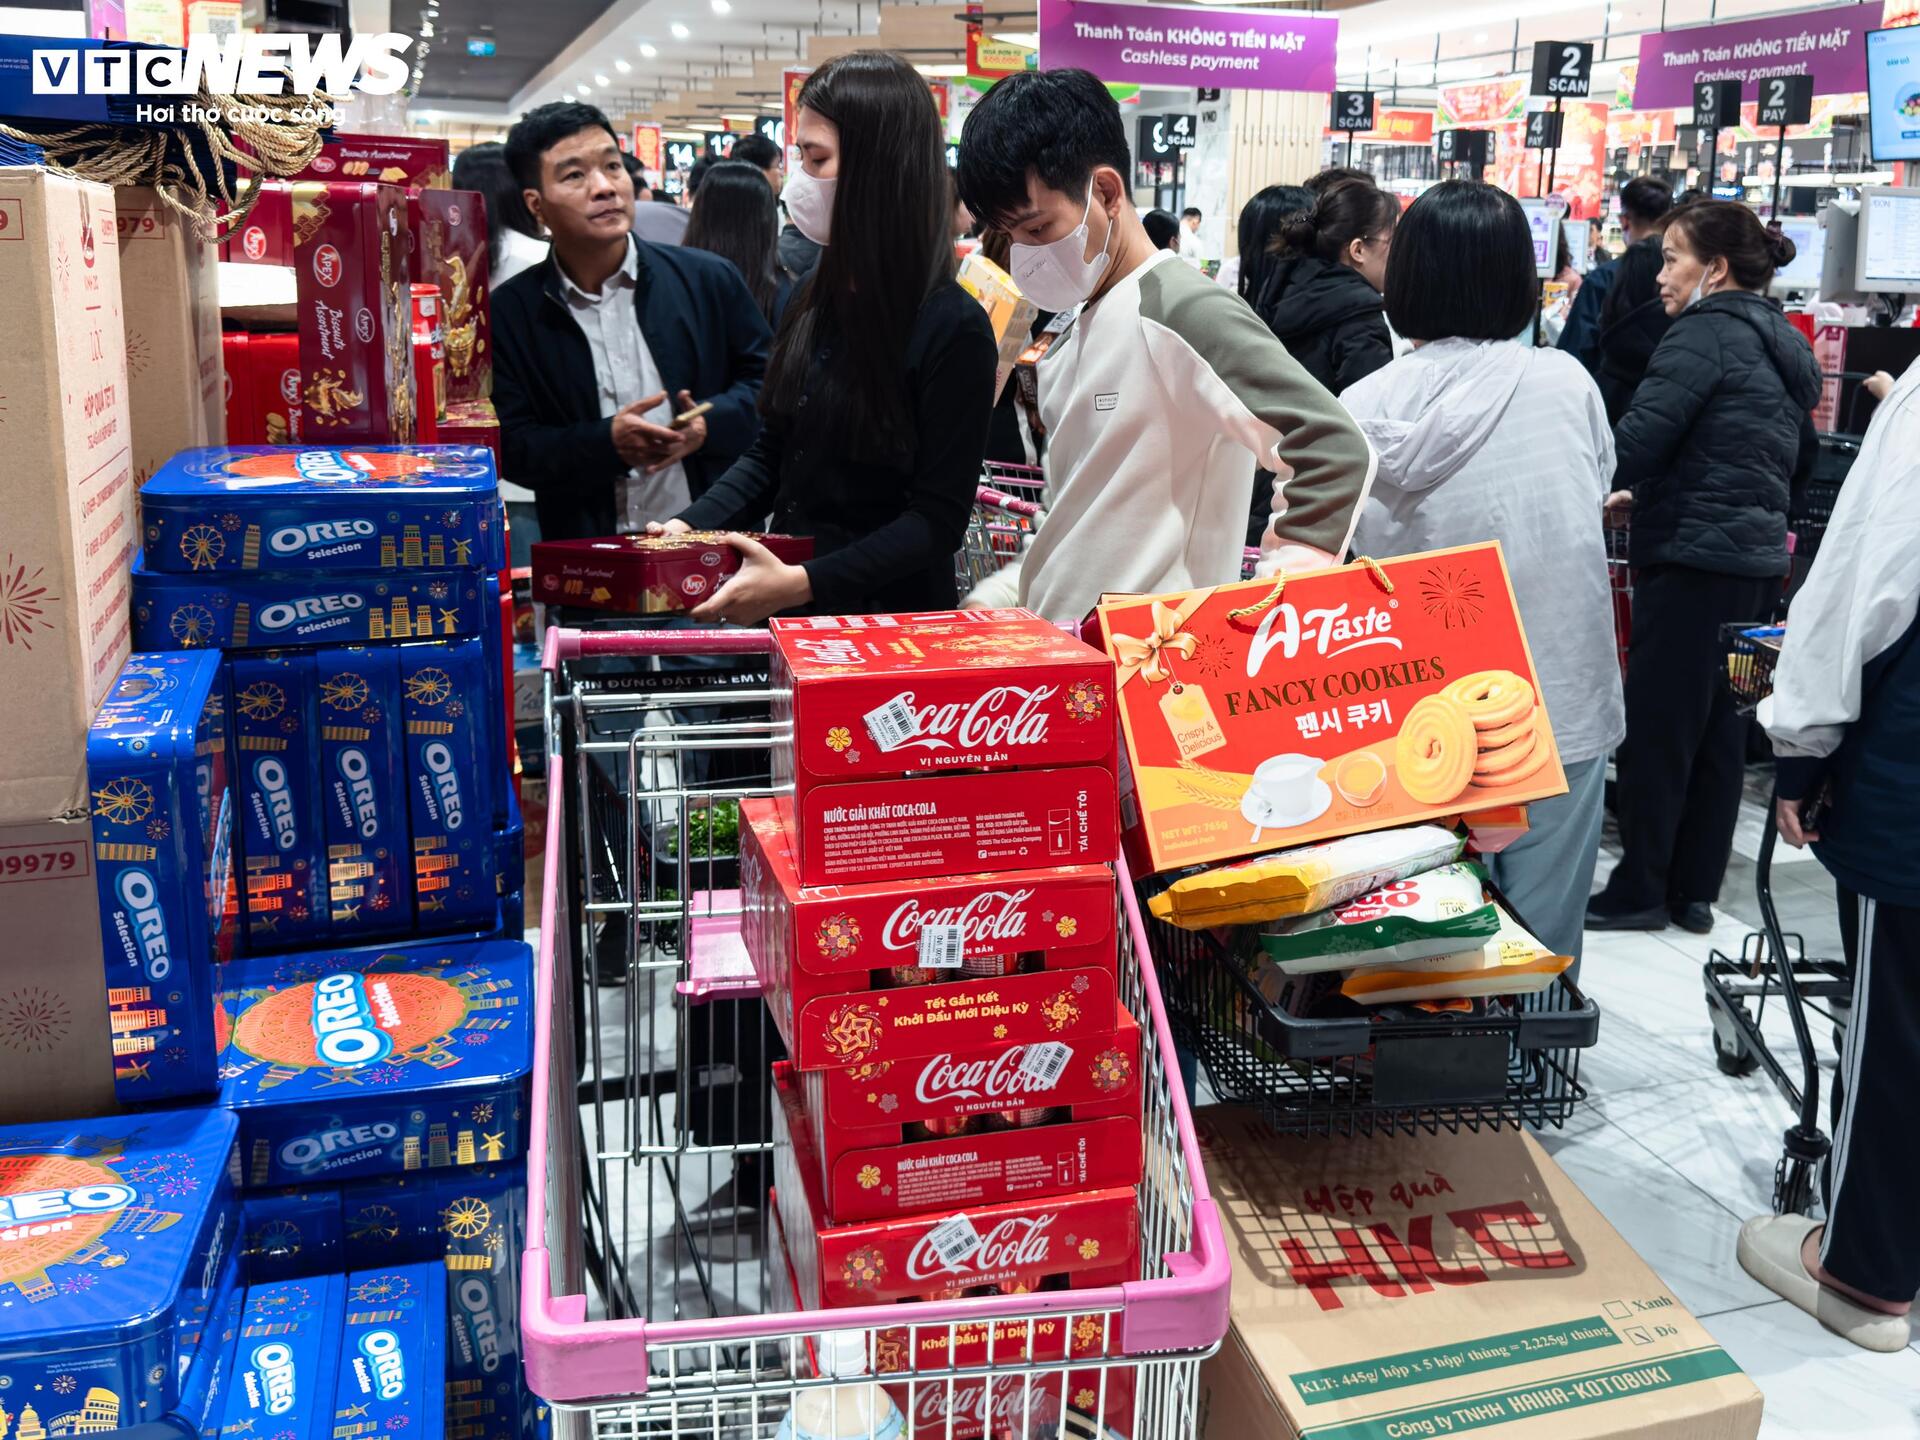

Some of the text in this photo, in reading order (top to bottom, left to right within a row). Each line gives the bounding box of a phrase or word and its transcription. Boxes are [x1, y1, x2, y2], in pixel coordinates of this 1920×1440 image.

[1074, 22, 1124, 40] Thanh
[1127, 26, 1163, 43] Toán
[1167, 27, 1227, 48] KHÔNG
[1270, 31, 1306, 55] MẶT
[1663, 51, 1701, 68] Thanh
[1702, 46, 1731, 65] Toán
[1733, 38, 1783, 60] KHÔNG
[1819, 30, 1851, 56] MẶT
[1120, 49, 1260, 72] Cashless payment
[1560, 46, 1582, 77] 2
[1548, 77, 1588, 94] SCAN
[1701, 86, 1714, 110] 3
[1768, 80, 1786, 107] 2
[1348, 93, 1365, 116] 3
[1763, 108, 1787, 122] PAY
[1174, 116, 1190, 136] 4
[1338, 117, 1372, 129] SCAN
[1530, 114, 1544, 134] 4
[1697, 113, 1716, 126] PAY
[1167, 135, 1195, 146] SCAN
[1527, 136, 1543, 147] PAY
[669, 143, 696, 168] 14
[320, 252, 335, 287] APEX
[314, 299, 335, 361] Assortment
[329, 308, 347, 351] Biscuits
[270, 519, 376, 552] OREO
[307, 541, 362, 560] Selection
[686, 578, 706, 594] APEX
[258, 593, 364, 629] OREO
[297, 616, 350, 634] Selection
[1246, 602, 1392, 678] A-Taste
[573, 680, 602, 691] XIN
[607, 674, 657, 689] ĐỪNG
[731, 673, 756, 685] EM
[1225, 656, 1446, 716] FANCY COOKIES
[1177, 721, 1214, 744] Crispy &
[1295, 698, 1393, 740] 팬시 쿠키
[1182, 731, 1223, 756] Delicious
[920, 751, 1009, 768] VỊ NGUYÊN BẢN
[341, 747, 378, 840] OREO
[419, 774, 439, 820] Selection
[425, 742, 463, 832] OREO
[251, 791, 271, 840] Selection
[257, 758, 297, 850] OREO
[333, 781, 354, 828] Selection
[824, 806, 848, 823] NƯỚC
[849, 804, 867, 821] GIẢI
[868, 802, 891, 819] KHÁT
[1076, 790, 1089, 853] TÁI CHẾ TÔI
[121, 871, 172, 981] OREO
[882, 888, 1036, 951] Coca-Cola
[112, 911, 138, 968] Selection
[975, 945, 994, 954] BẢN
[370, 983, 402, 1028] Selection
[894, 1001, 1030, 1027] Khởi Đầu Mới Diệu Kỳ
[925, 991, 999, 1009] Tết Gắn Kết
[320, 973, 381, 1064] OREO
[954, 1098, 1025, 1113] VỊ NGUYÊN BẢN
[281, 1122, 397, 1165] OREO
[1077, 1137, 1086, 1152] TÔI
[323, 1148, 383, 1171] Selection
[929, 1154, 945, 1168] KHÁT
[1077, 1154, 1086, 1171] CHẾ
[1388, 1169, 1455, 1210] quà
[946, 1270, 1017, 1288] VỊ NGUYÊN BẢN
[1631, 1295, 1674, 1313] Xanh
[451, 1314, 474, 1363] Selection
[460, 1277, 499, 1373] OREO
[1038, 1321, 1056, 1335] Kỳ
[1653, 1322, 1679, 1338] Đỏ
[365, 1330, 405, 1400] OREO
[1300, 1323, 1613, 1395] KLT: 445g/ hộp x 5 hộp/ thùng = 2,225g/ thùng
[244, 1370, 258, 1409] Selection
[257, 1344, 294, 1415] OREO
[353, 1356, 371, 1394] Selection
[1386, 1366, 1673, 1439] Công ty TNHH HAIHA-KOTOBUKI
